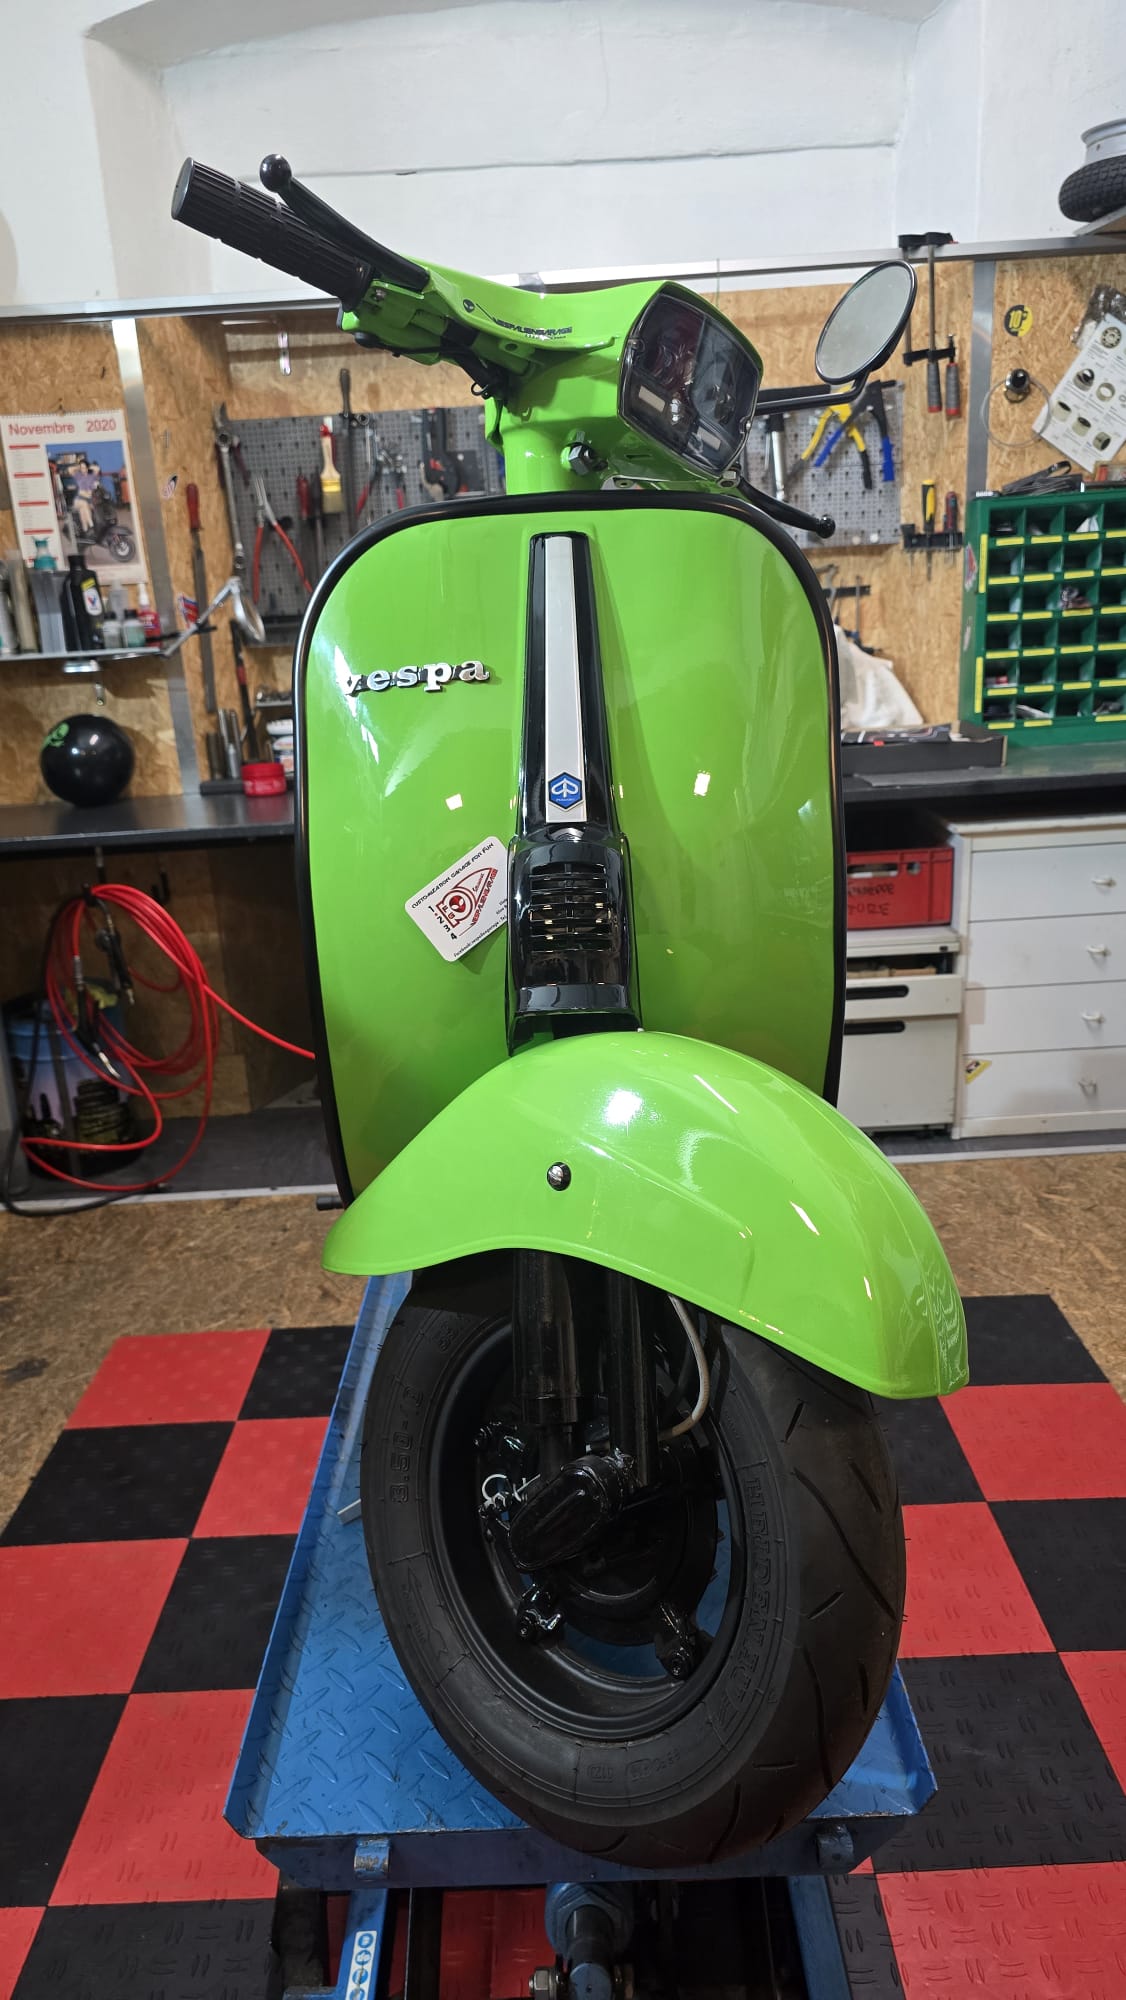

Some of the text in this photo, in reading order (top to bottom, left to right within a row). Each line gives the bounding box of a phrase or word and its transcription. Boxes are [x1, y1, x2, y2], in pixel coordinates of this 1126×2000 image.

[8, 417, 117, 436] Novembre 2020
[450, 932, 458, 941] 4
[730, 1477, 772, 1705] HEIDENAU
